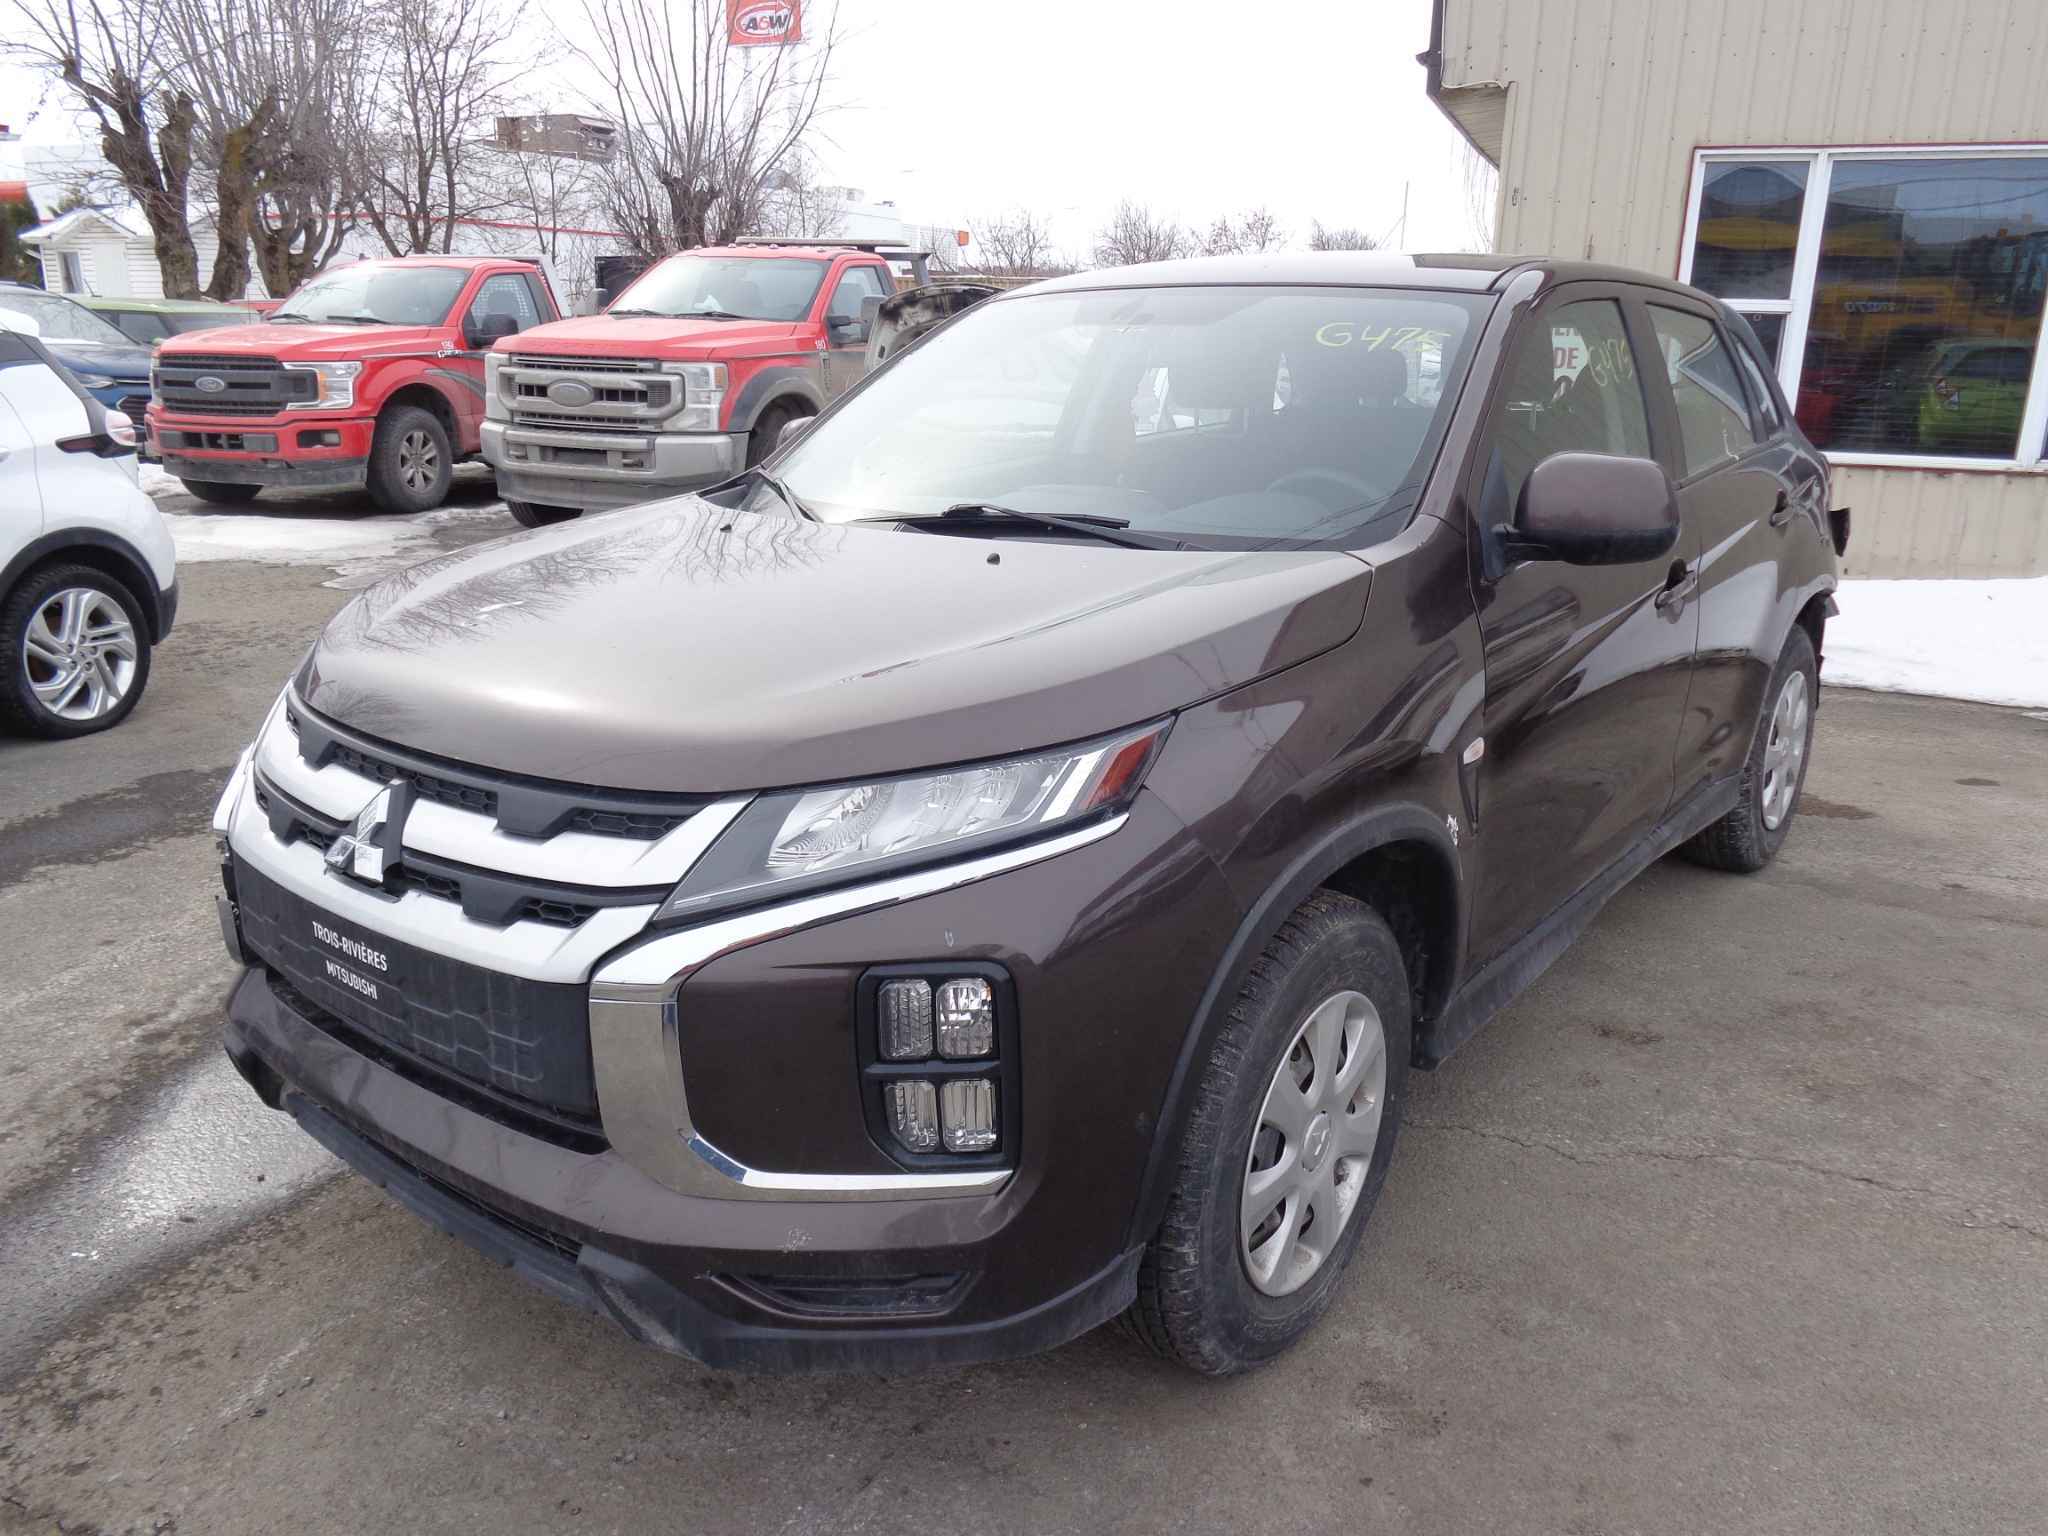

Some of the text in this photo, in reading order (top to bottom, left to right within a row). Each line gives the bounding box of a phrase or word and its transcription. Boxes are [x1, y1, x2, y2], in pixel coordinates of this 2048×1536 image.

[744, 14, 789, 31] A&W
[1315, 321, 1453, 353] G475
[1553, 346, 1579, 369] DE
[312, 920, 388, 972] TROIS-RIVIÈRES
[326, 959, 378, 1000] MITSUBISHI
